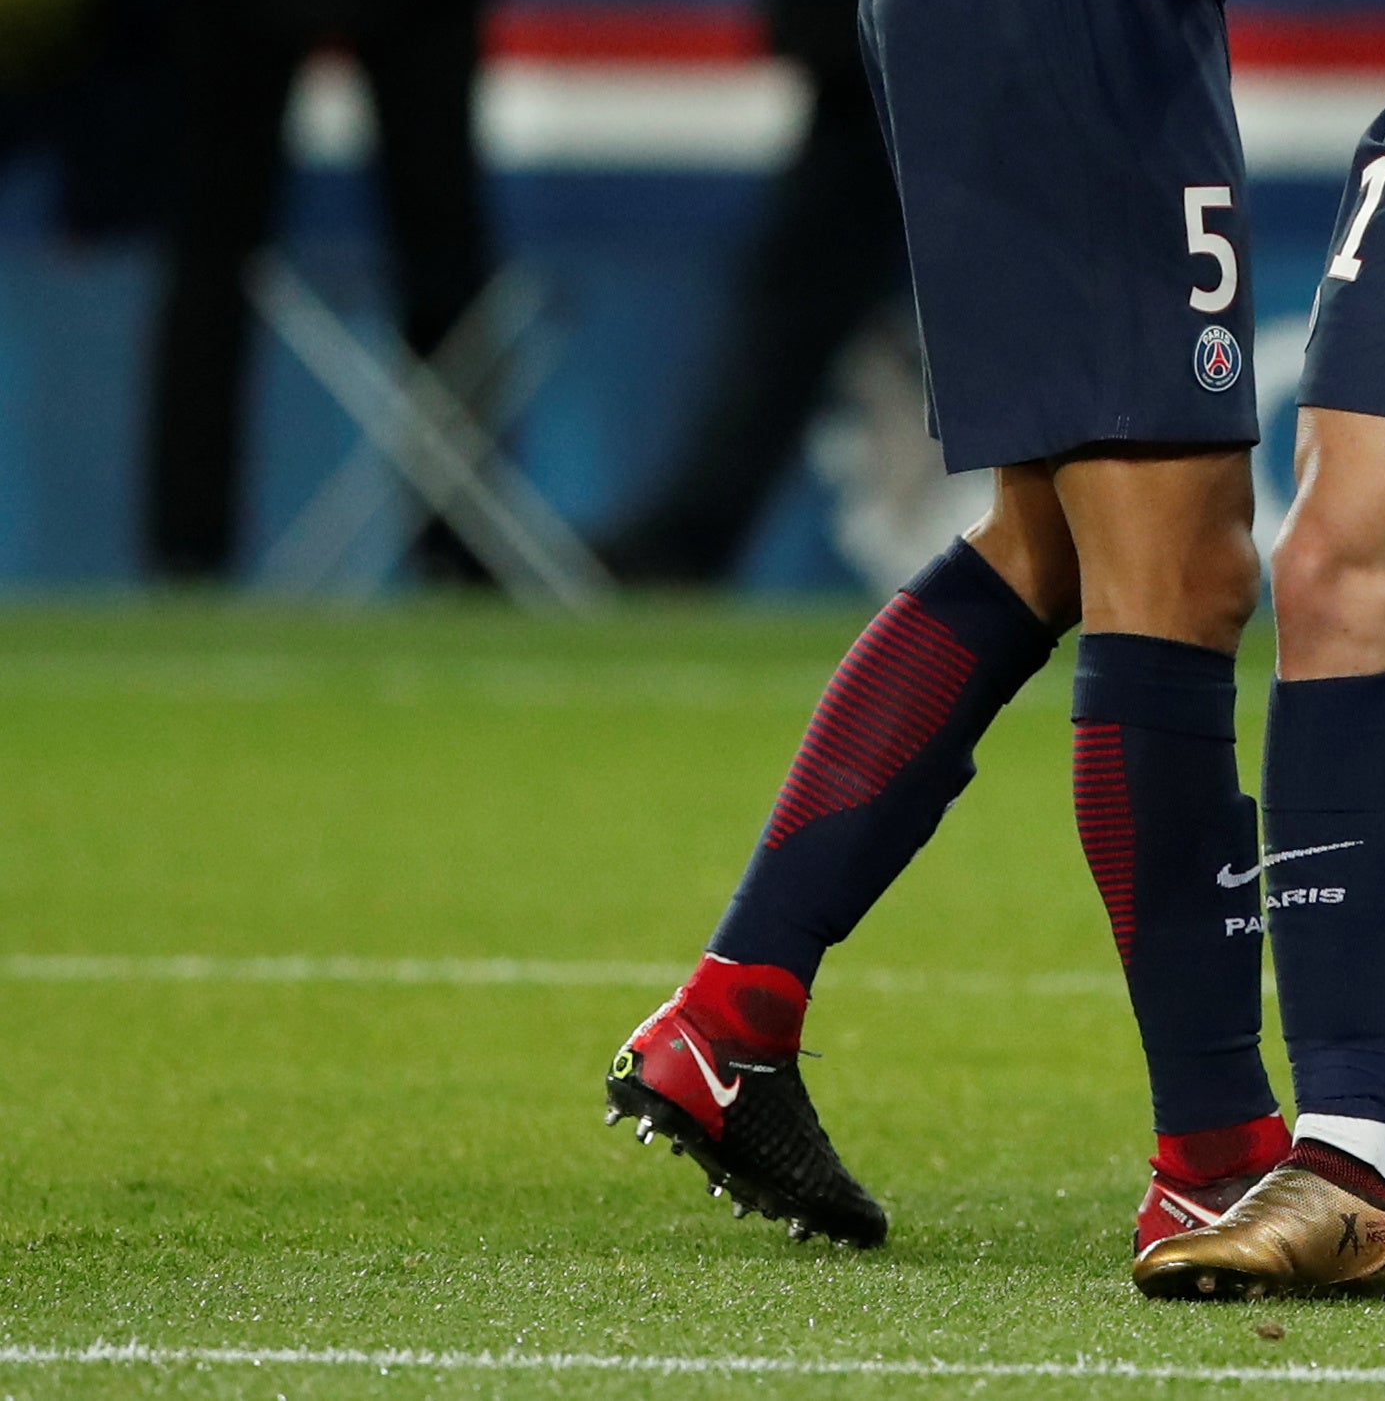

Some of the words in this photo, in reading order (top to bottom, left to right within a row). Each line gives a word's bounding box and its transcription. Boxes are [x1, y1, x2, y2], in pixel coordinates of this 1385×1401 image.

[1183, 184, 1238, 313] 5
[1201, 329, 1231, 346] PARIS
[1263, 887, 1346, 910] ARIS
